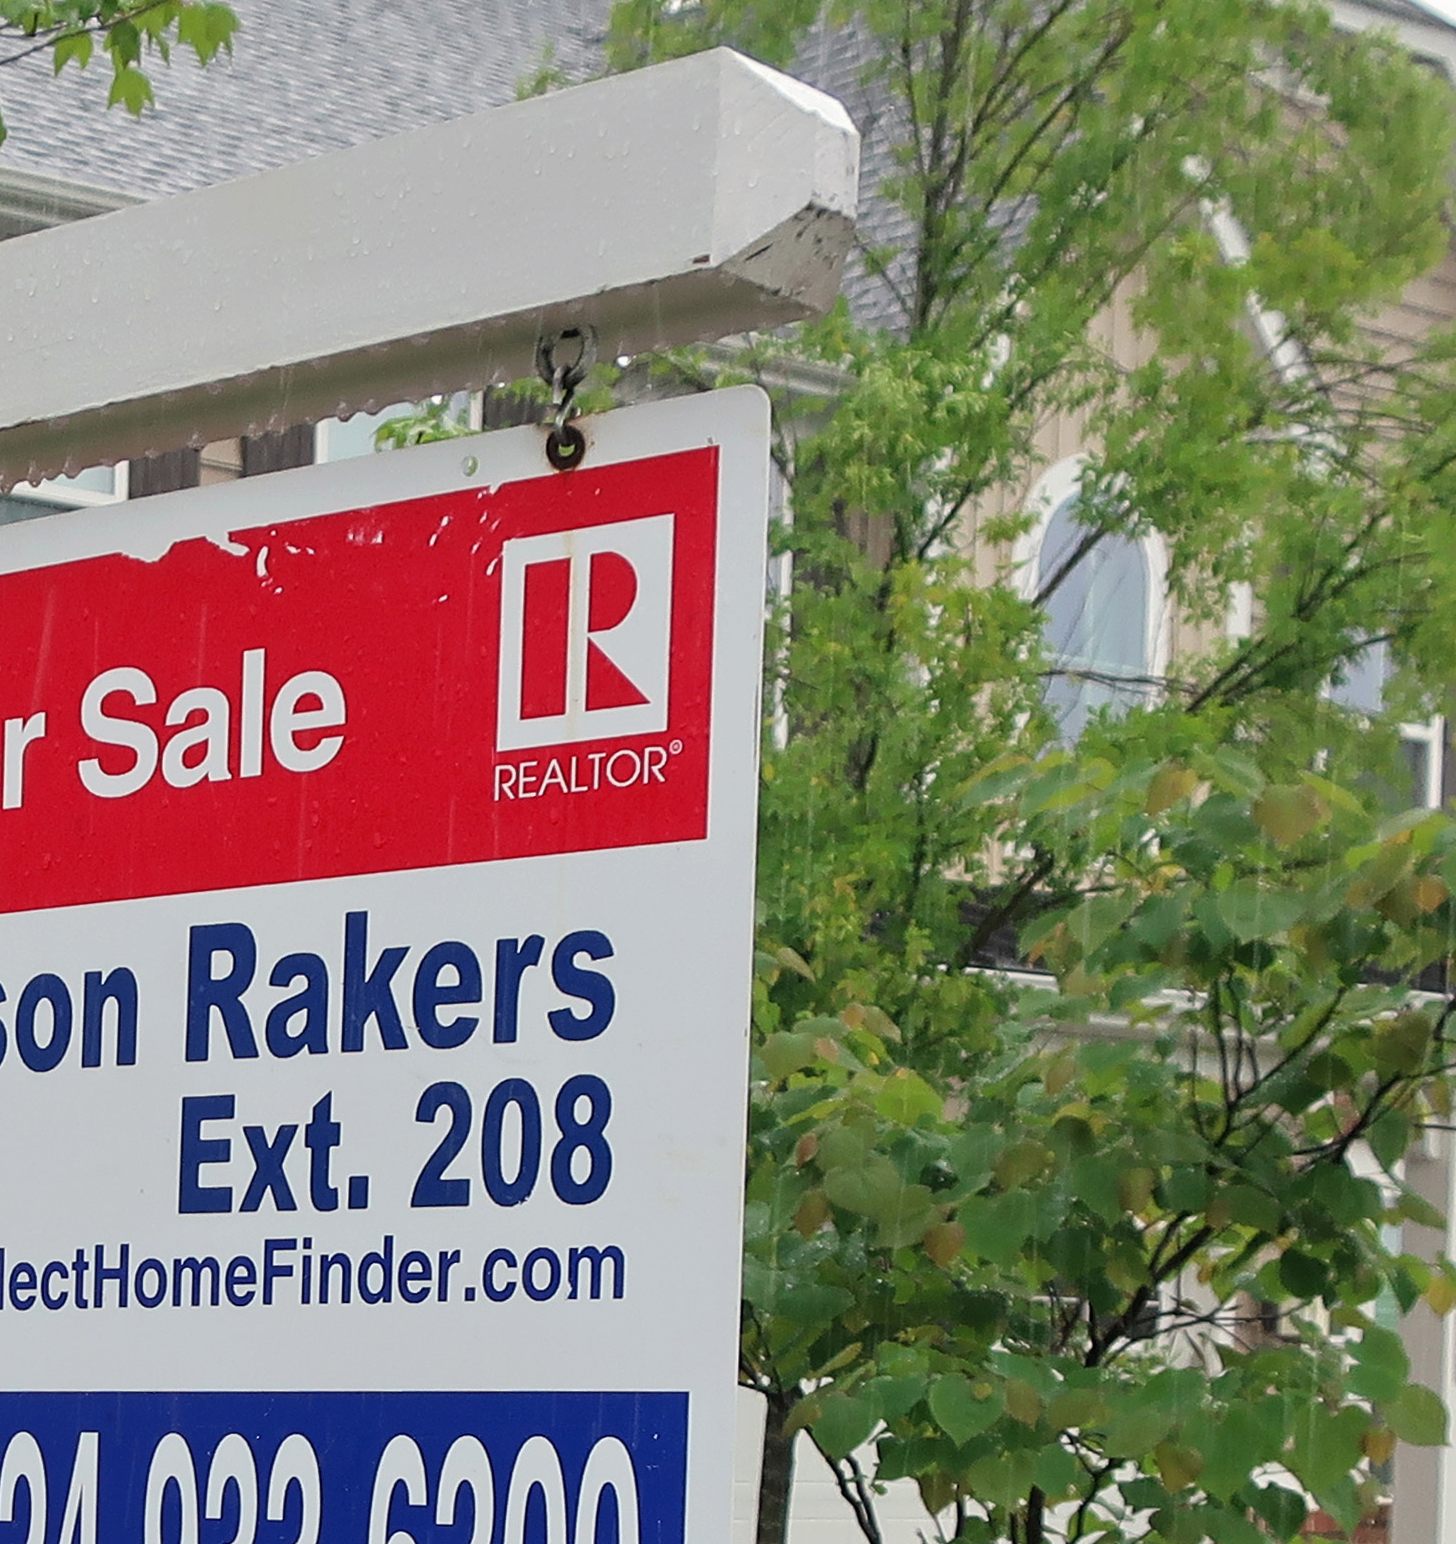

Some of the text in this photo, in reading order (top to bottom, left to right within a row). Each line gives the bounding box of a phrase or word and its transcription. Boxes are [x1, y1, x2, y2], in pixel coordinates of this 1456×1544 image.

[77, 648, 347, 799] Sale
[184, 911, 616, 1062] Rakers
[177, 1074, 613, 1215] Ext. 208
